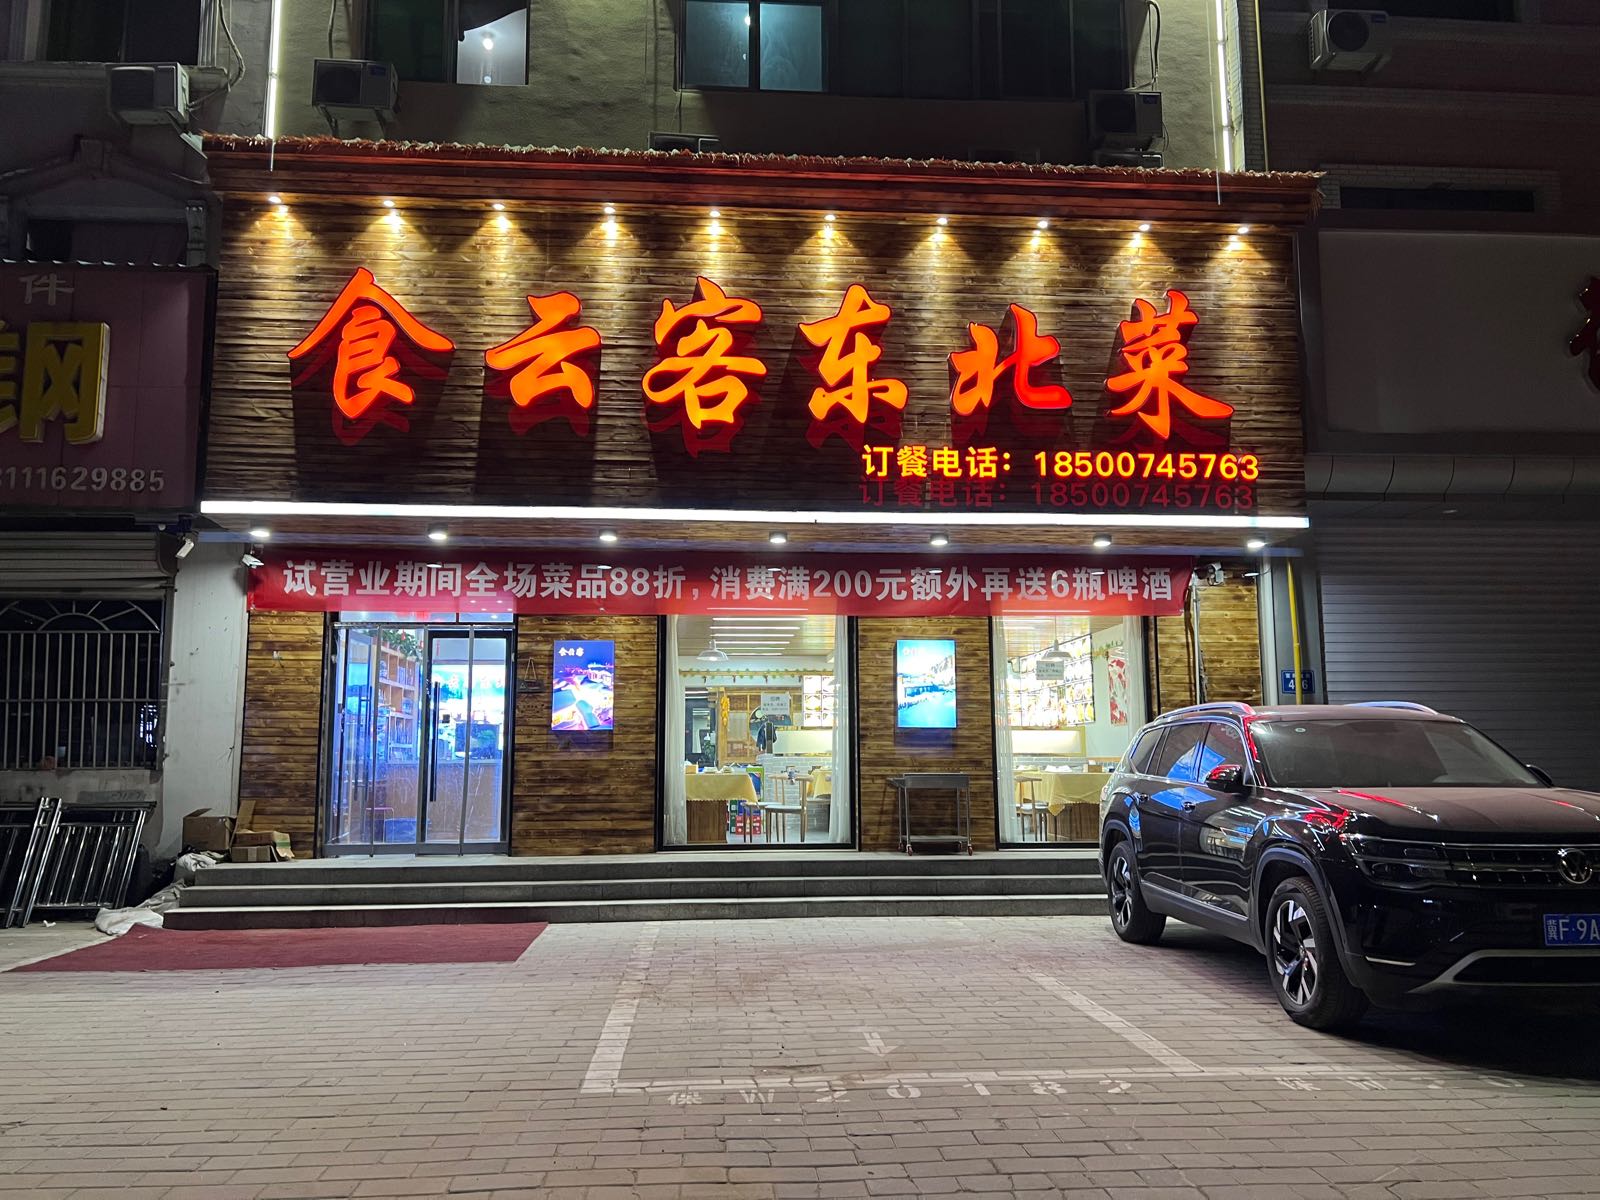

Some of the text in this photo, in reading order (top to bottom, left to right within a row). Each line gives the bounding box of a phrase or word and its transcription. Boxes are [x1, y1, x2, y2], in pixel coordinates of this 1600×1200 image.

[18, 273, 75, 306] 件
[288, 267, 1234, 440] 食云客东北菜
[0, 466, 166, 493] 111629885
